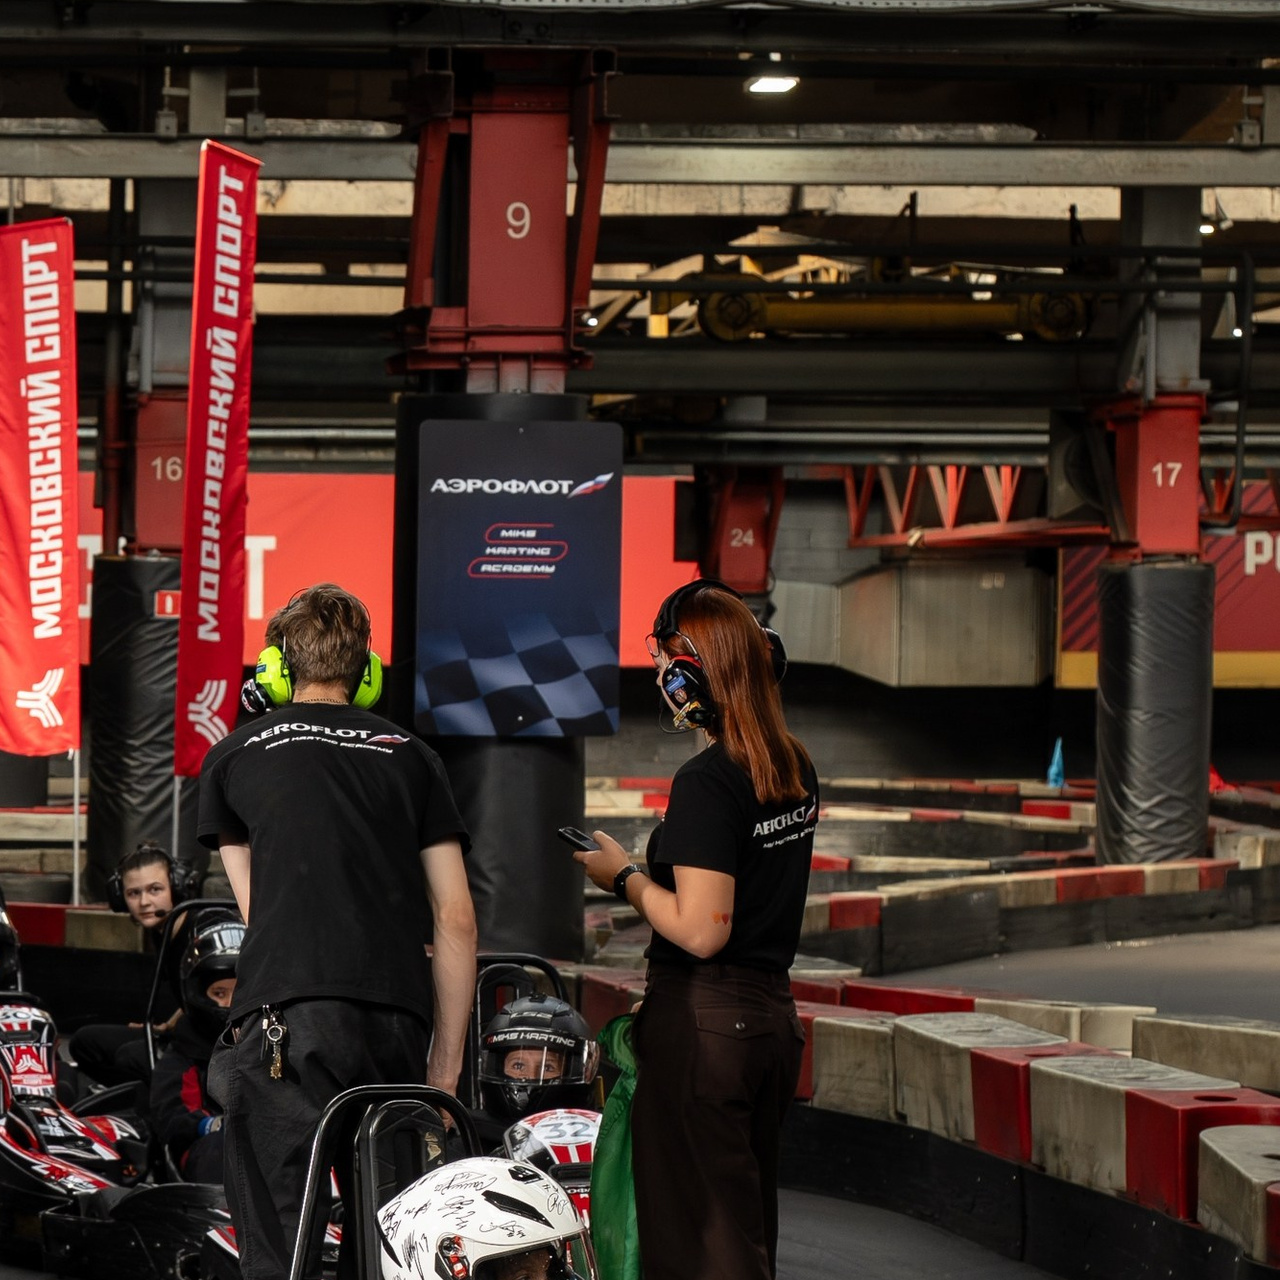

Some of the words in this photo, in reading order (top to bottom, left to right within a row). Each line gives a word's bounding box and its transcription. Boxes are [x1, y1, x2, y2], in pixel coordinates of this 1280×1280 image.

[506, 202, 531, 239] 9
[212, 165, 243, 318] СПОРТ
[22, 239, 61, 363] СПОРТ
[150, 455, 183, 481] 16
[1152, 462, 1182, 488] 17
[198, 327, 238, 642] МОСКОВСКИЙ
[430, 478, 573, 495] АЭРОФЛОТ
[21, 370, 62, 639] МОСКОВСКИЙ
[730, 529, 755, 547] 24
[485, 546, 551, 556] KARTING
[480, 564, 555, 573] ACADEMY
[244, 722, 371, 747] AEROFLOT
[520, 1032, 575, 1048] KARTING
[541, 1121, 593, 1139] 32
